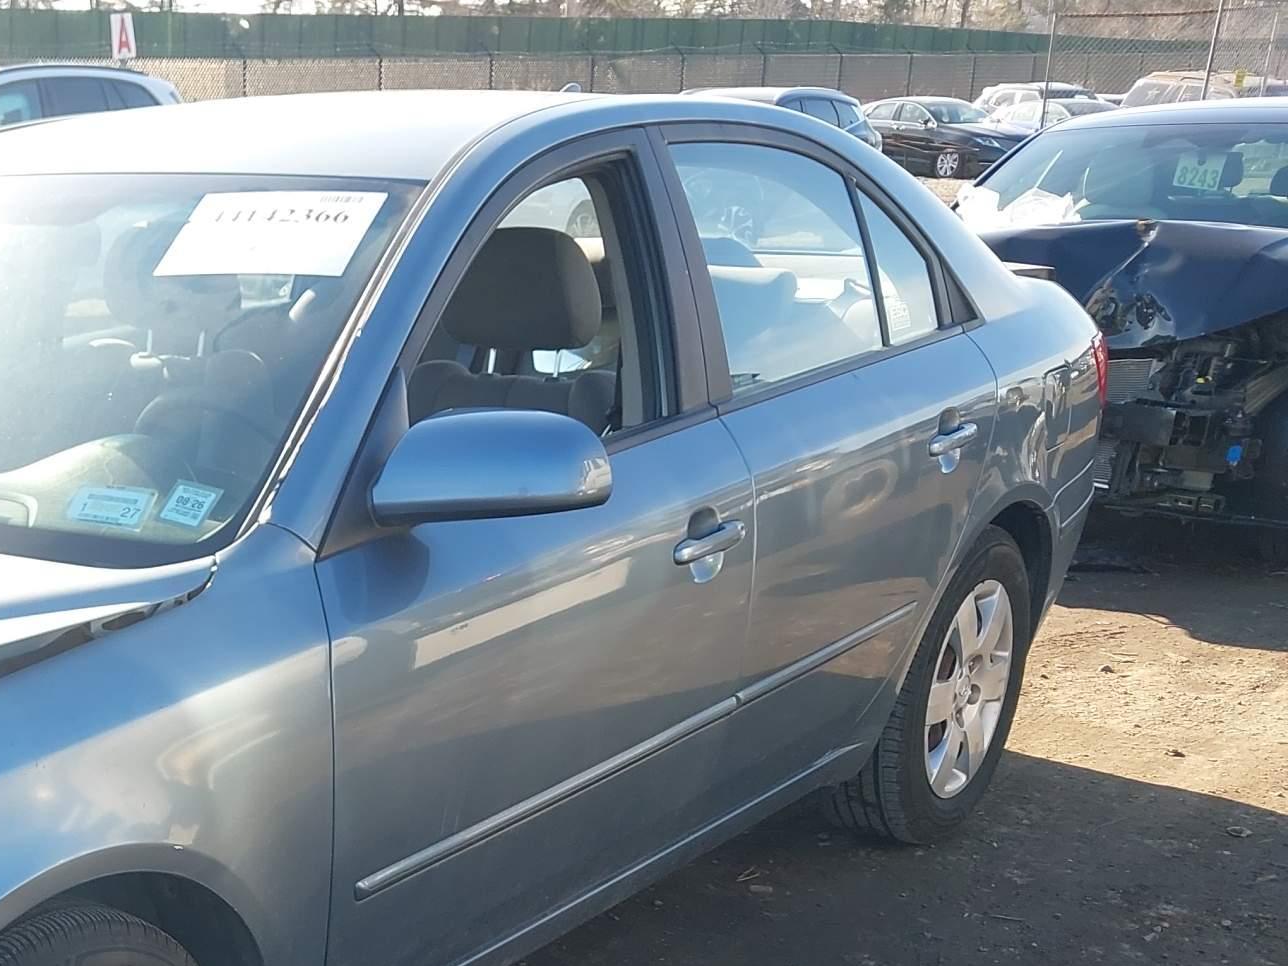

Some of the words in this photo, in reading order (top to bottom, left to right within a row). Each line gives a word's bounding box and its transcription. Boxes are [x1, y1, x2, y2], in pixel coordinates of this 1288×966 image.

[118, 14, 132, 54] A
[1176, 165, 1219, 189] 8243
[120, 506, 142, 520] 27
